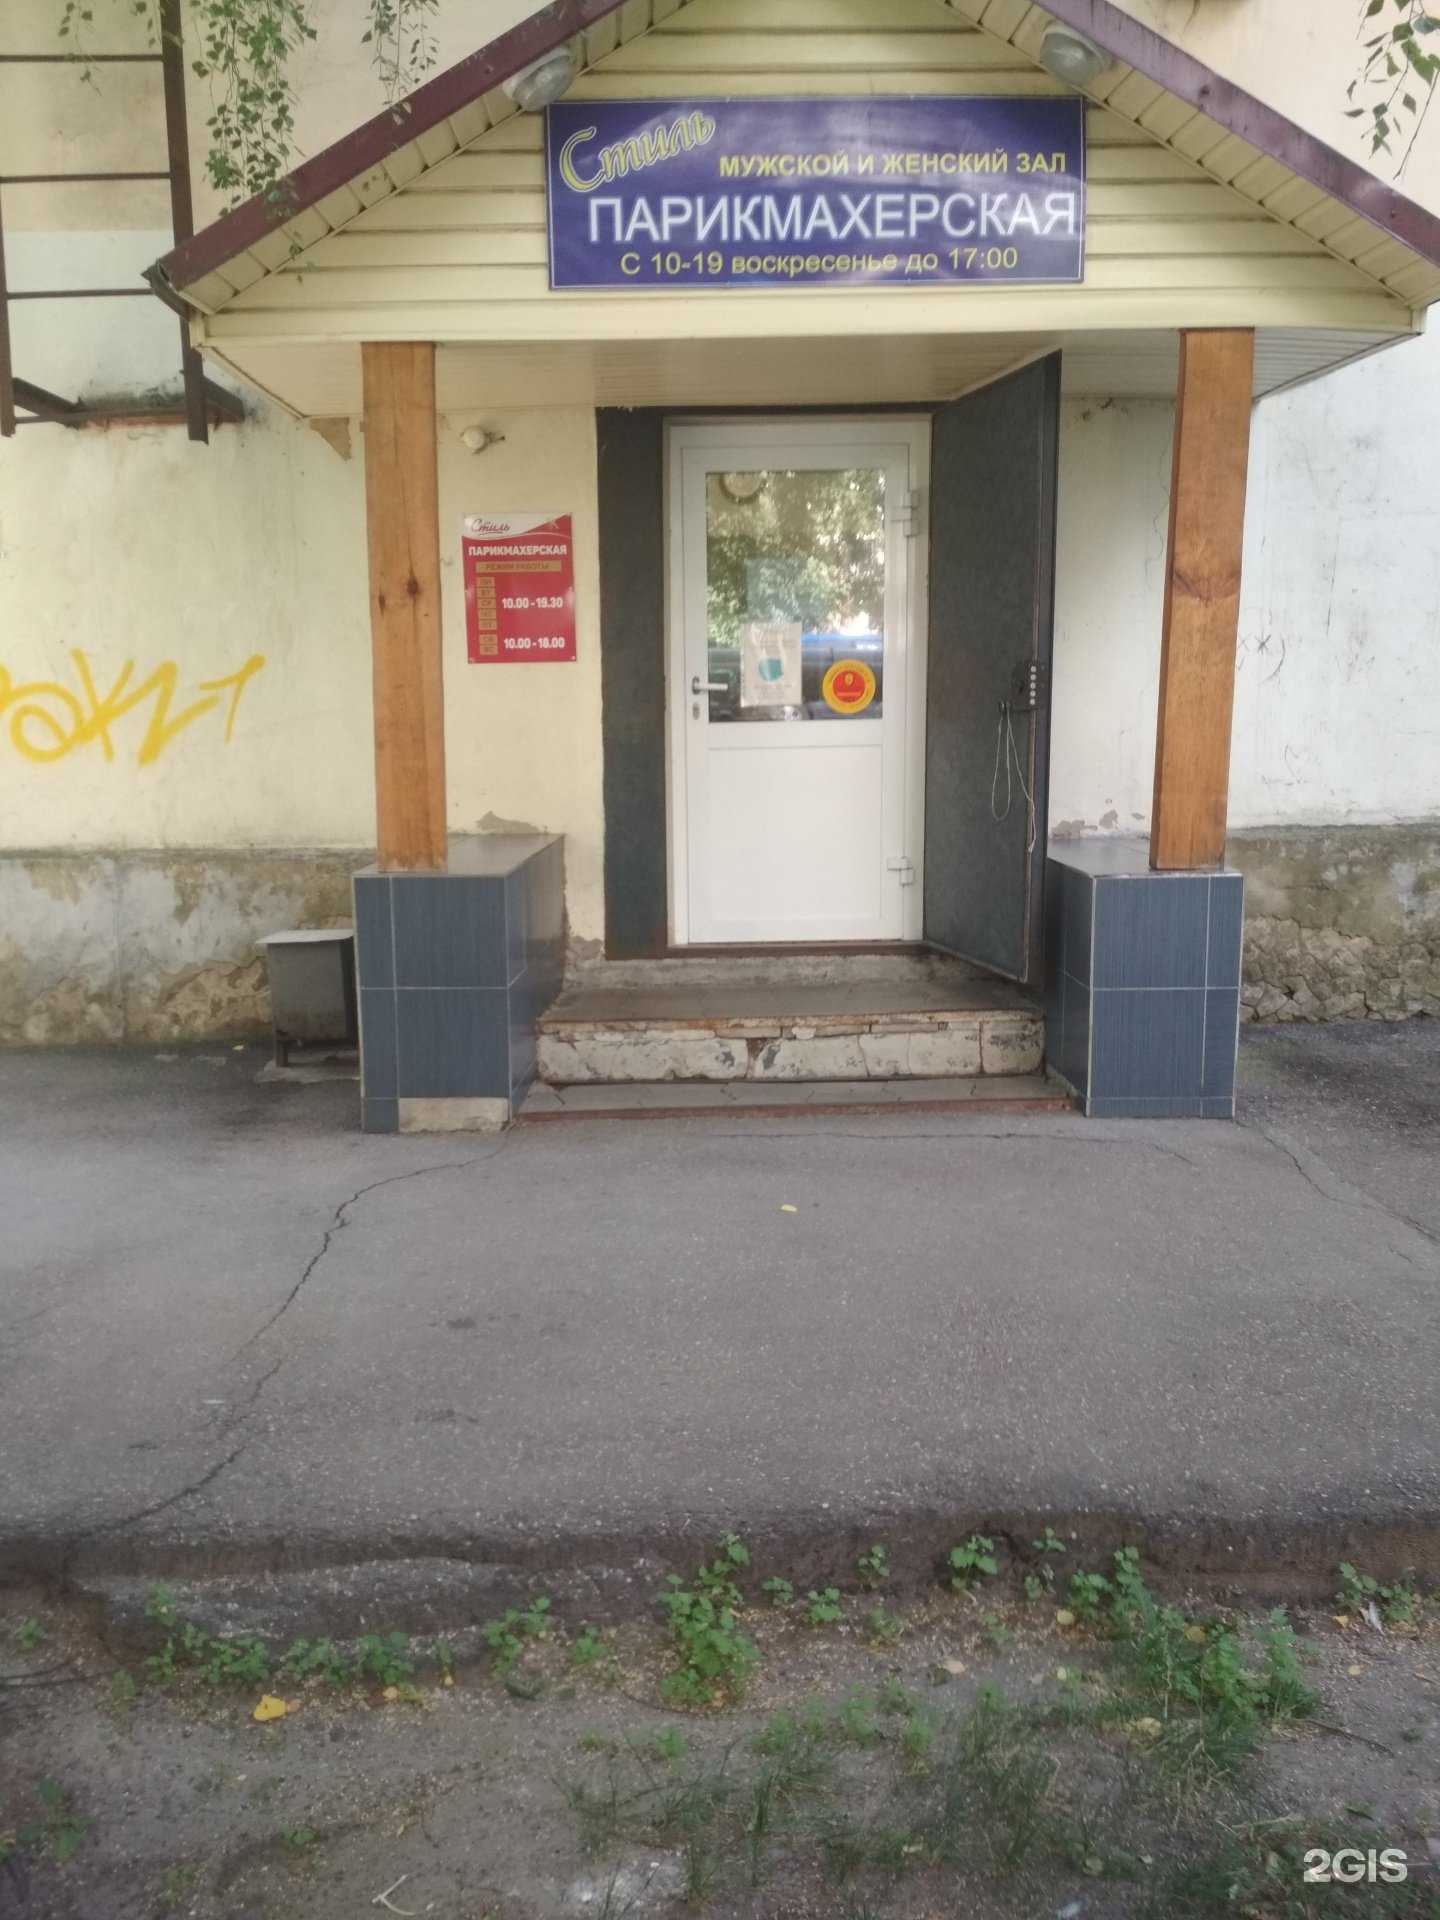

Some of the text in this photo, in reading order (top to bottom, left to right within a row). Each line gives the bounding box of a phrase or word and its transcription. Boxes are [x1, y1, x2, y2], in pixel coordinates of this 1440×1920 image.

[560, 110, 716, 192] Стиль
[719, 147, 1067, 177] МУЖСКОЙ И ЖЕНСКИЙ ЗАЛ
[589, 191, 1076, 242] ПАРИКМАХЕРСКАЯ
[620, 247, 1018, 278] С 10-19 воскресенье до 17:00
[468, 544, 568, 557] ПАРИКМАХЕРСКАЯ
[502, 597, 529, 609] 10.00
[504, 637, 531, 649] 10.00
